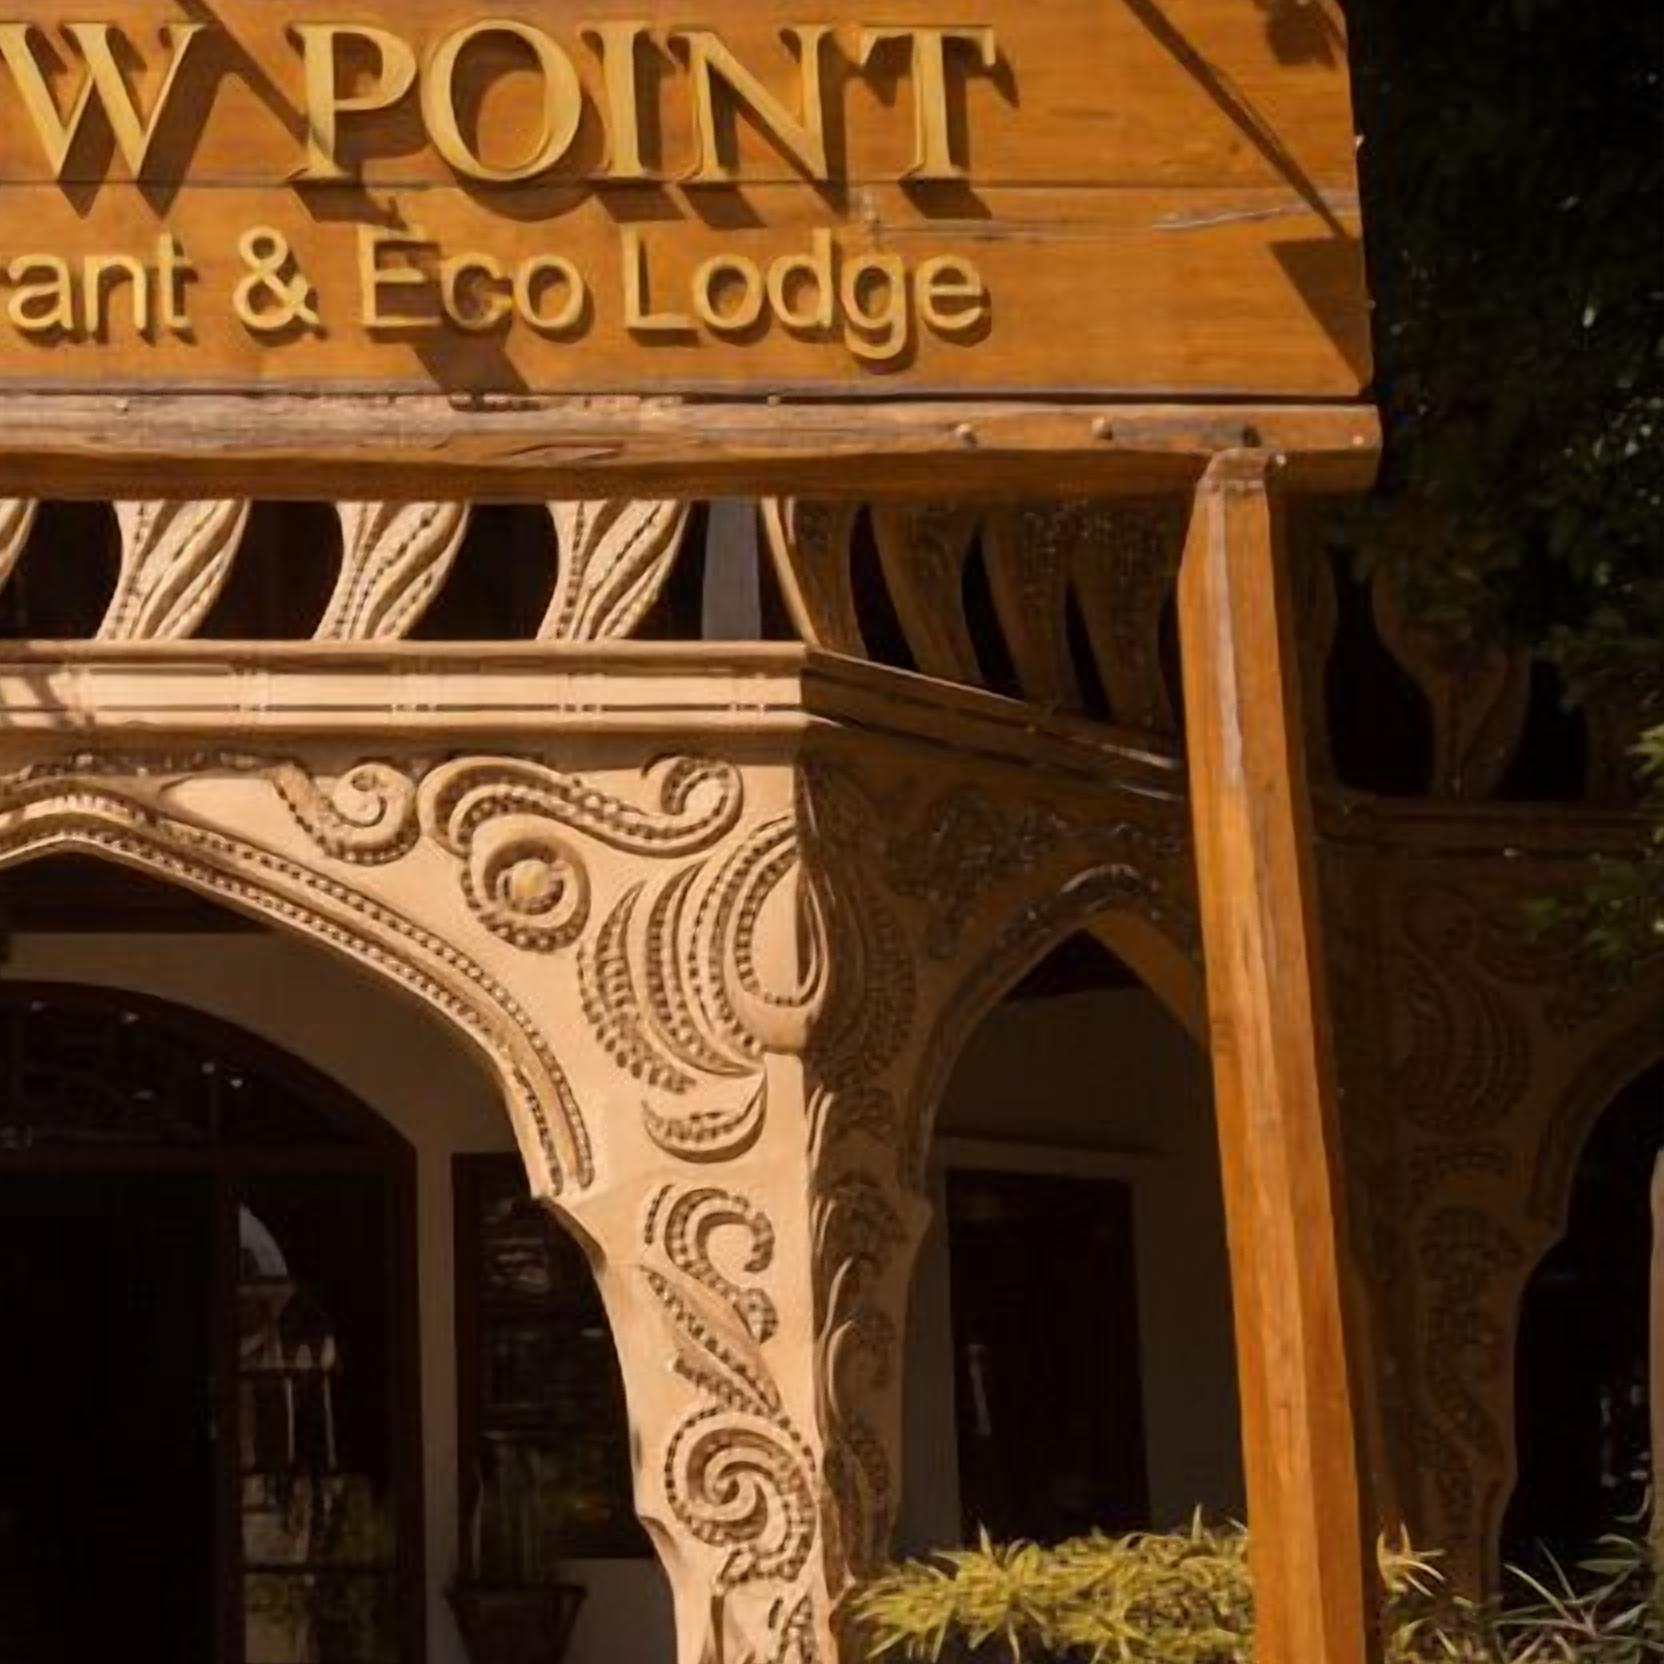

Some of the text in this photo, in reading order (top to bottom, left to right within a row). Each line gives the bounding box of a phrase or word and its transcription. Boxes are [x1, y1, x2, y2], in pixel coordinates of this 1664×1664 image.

[286, 18, 996, 185] POINT
[236, 227, 318, 335] &
[362, 228, 584, 335] Eco
[624, 225, 984, 362] Lodge
